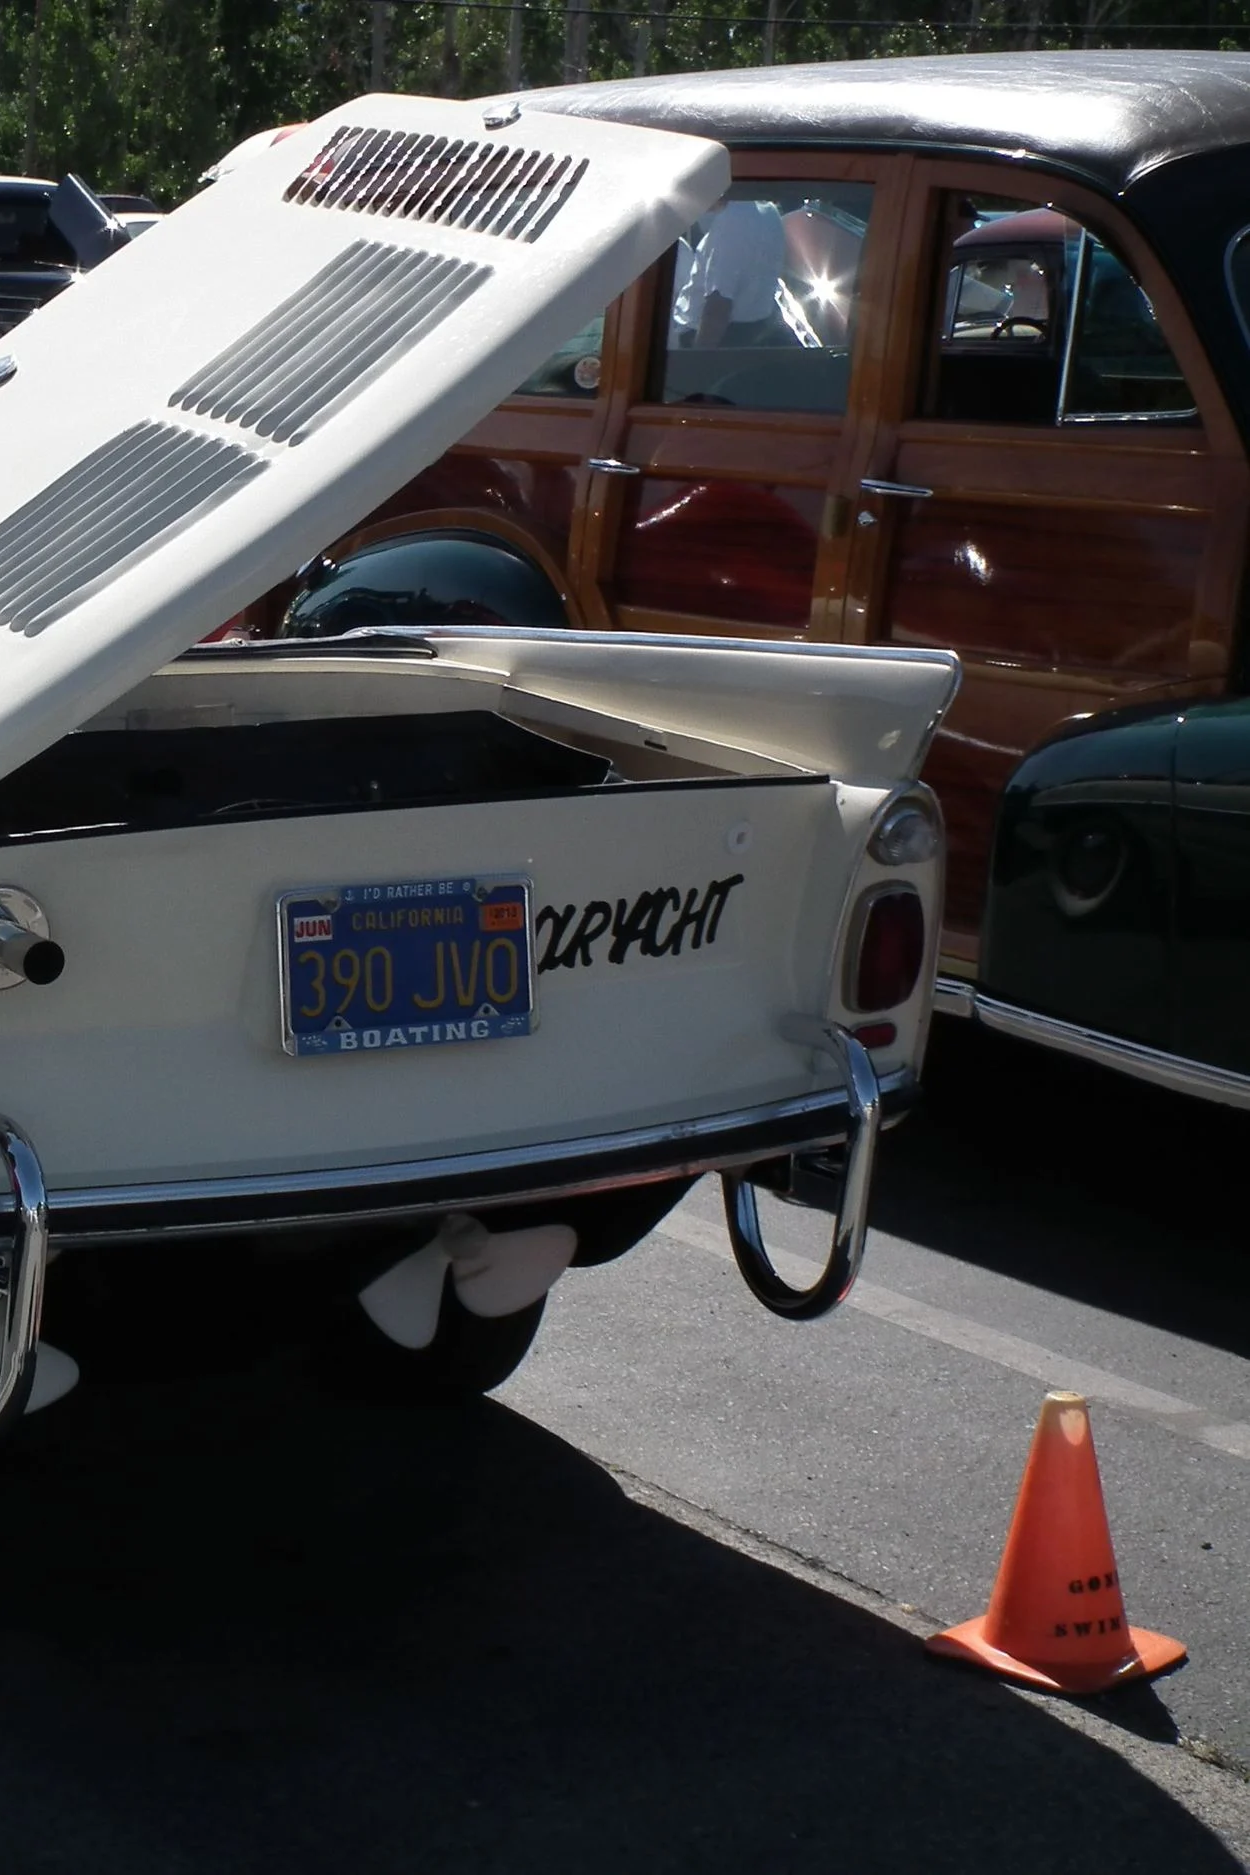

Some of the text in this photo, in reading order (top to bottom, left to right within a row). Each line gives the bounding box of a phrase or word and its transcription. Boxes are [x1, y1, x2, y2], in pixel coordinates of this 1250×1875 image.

[363, 881, 454, 900] I'D RATHER BE
[294, 919, 332, 939] JUN
[352, 905, 464, 931] CALIFORNIA
[298, 937, 519, 1017] 390 JVO
[339, 1020, 490, 1051] BOATING
